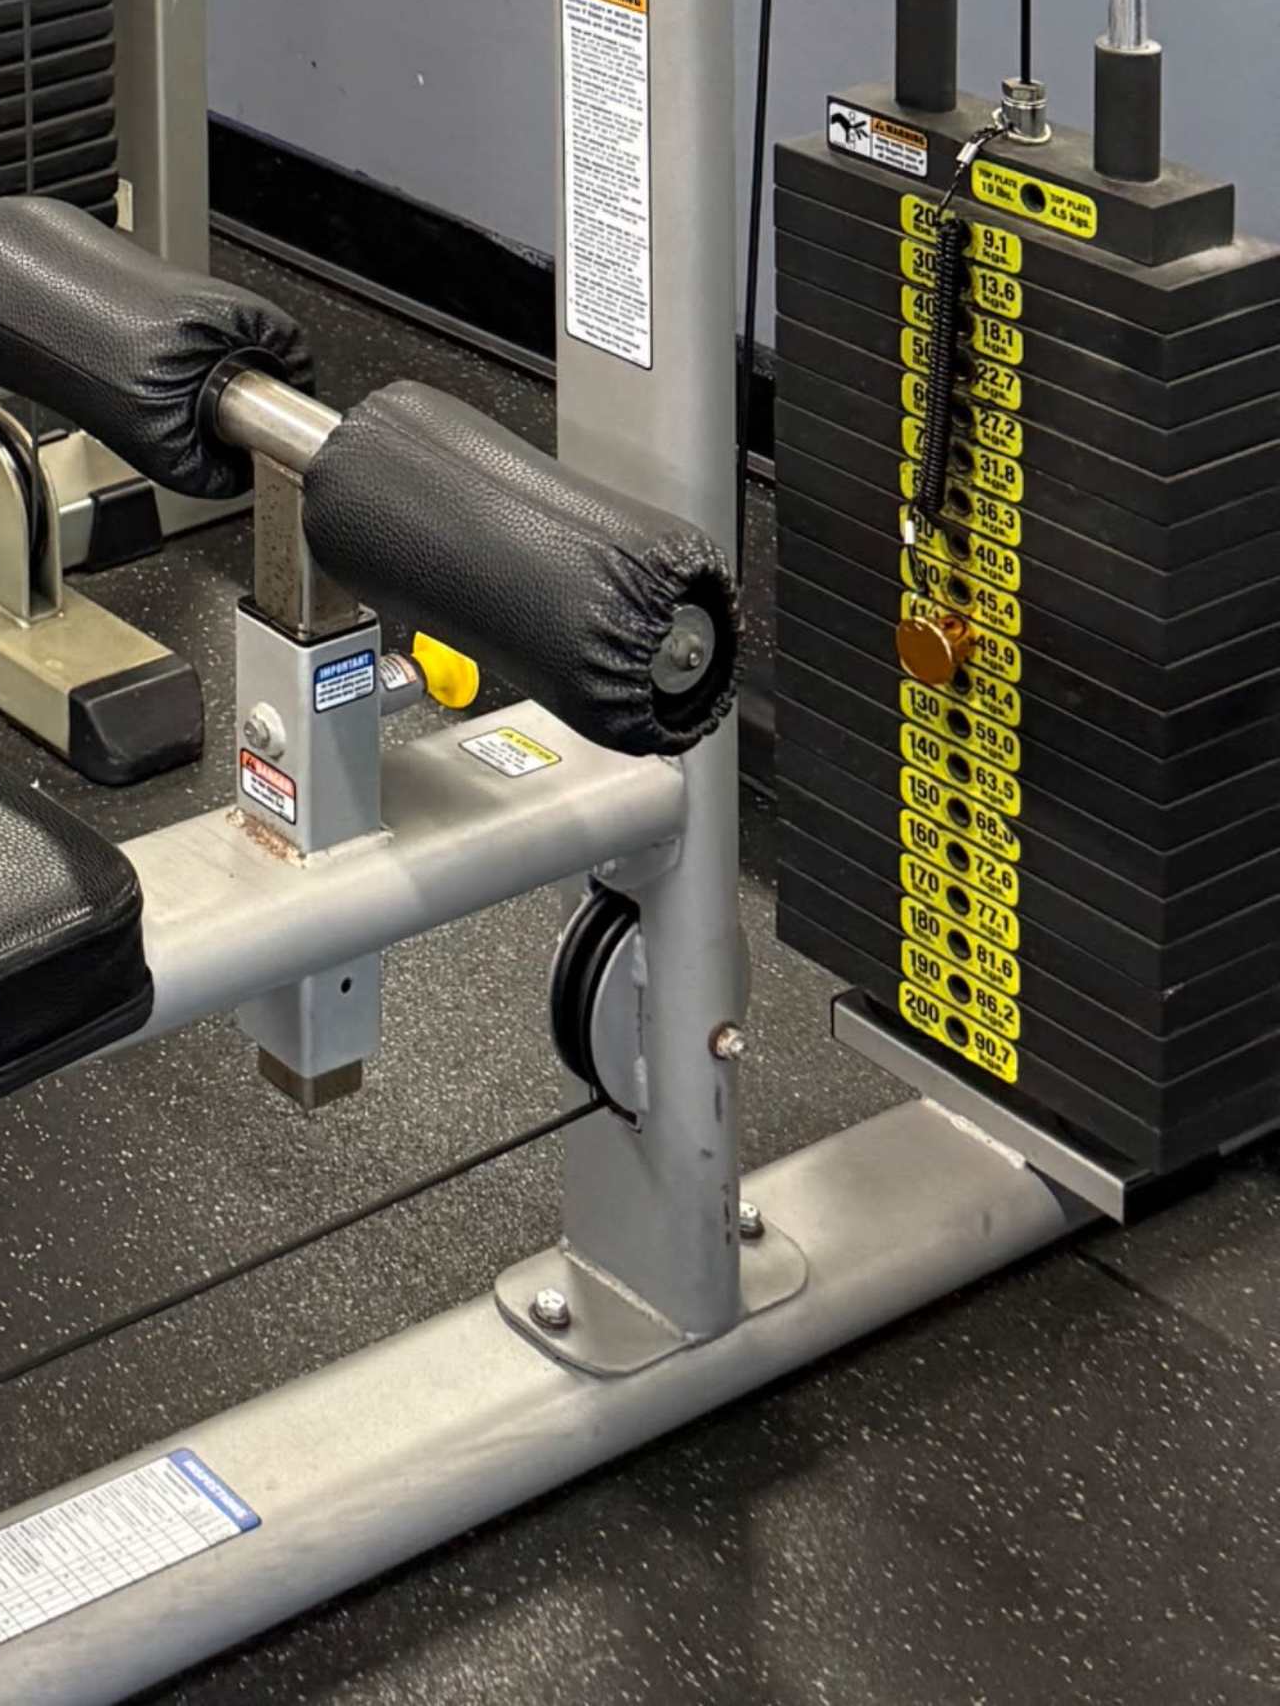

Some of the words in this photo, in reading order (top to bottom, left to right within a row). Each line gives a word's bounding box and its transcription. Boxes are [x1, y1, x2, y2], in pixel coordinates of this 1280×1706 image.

[913, 203, 937, 227] 20
[984, 229, 1007, 254] 9.1
[913, 247, 936, 272] 30
[980, 273, 1015, 302] 13.6
[913, 293, 936, 317] 40
[981, 320, 1013, 347] 18.1
[978, 363, 1015, 390] 22.7
[980, 412, 1016, 440] 27.2
[980, 454, 1015, 484] 31.8
[976, 498, 1015, 529] 36.3
[976, 544, 1014, 575] 40.8
[976, 589, 1014, 620] 45.4
[977, 635, 1015, 666] 49.9
[320, 653, 369, 680] IMPORTANT
[907, 686, 939, 717] 130
[975, 677, 1013, 709] 54.4
[908, 731, 940, 762] 140
[975, 721, 1014, 755] 59.0
[908, 775, 940, 806] 150
[976, 766, 1014, 800] 63.5
[907, 818, 939, 849] 160
[908, 861, 939, 893] 170
[974, 854, 1013, 889] 72.6
[908, 905, 940, 937] 180
[976, 899, 1010, 933] 77.1
[908, 949, 941, 981] 190
[976, 943, 1013, 979] 81.6
[905, 989, 939, 1023] 200
[976, 988, 1015, 1024] 86.2
[974, 1031, 1011, 1065] 90.7
